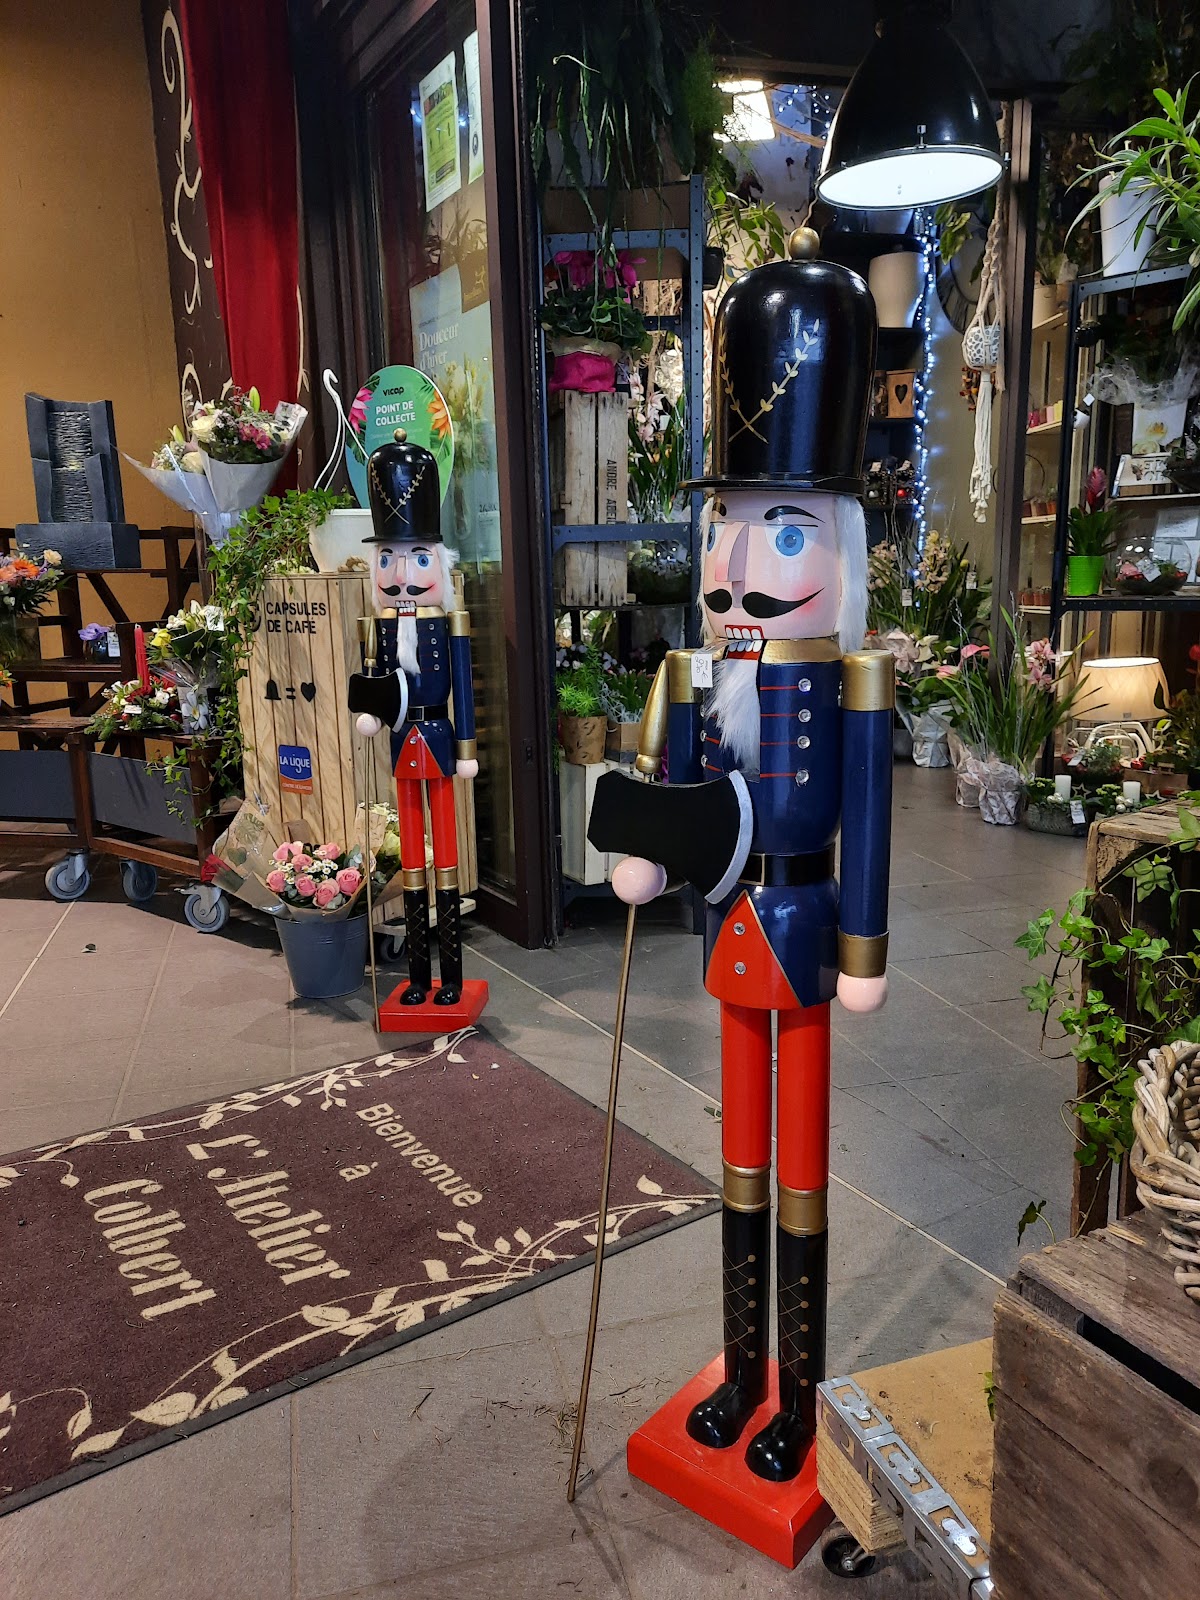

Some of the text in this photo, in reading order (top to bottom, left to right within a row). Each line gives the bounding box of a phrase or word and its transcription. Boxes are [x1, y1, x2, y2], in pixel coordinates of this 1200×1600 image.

[420, 323, 459, 351] Douceur
[376, 401, 414, 415] POINT DE
[376, 412, 416, 426] COLLECTE
[266, 602, 327, 616] CAPSULES
[267, 617, 317, 634] DE CAFÉ
[280, 756, 289, 765] LA
[356, 1103, 482, 1207] Bienvenue
[339, 1162, 379, 1182] à
[84, 1179, 217, 1320] Colbert
